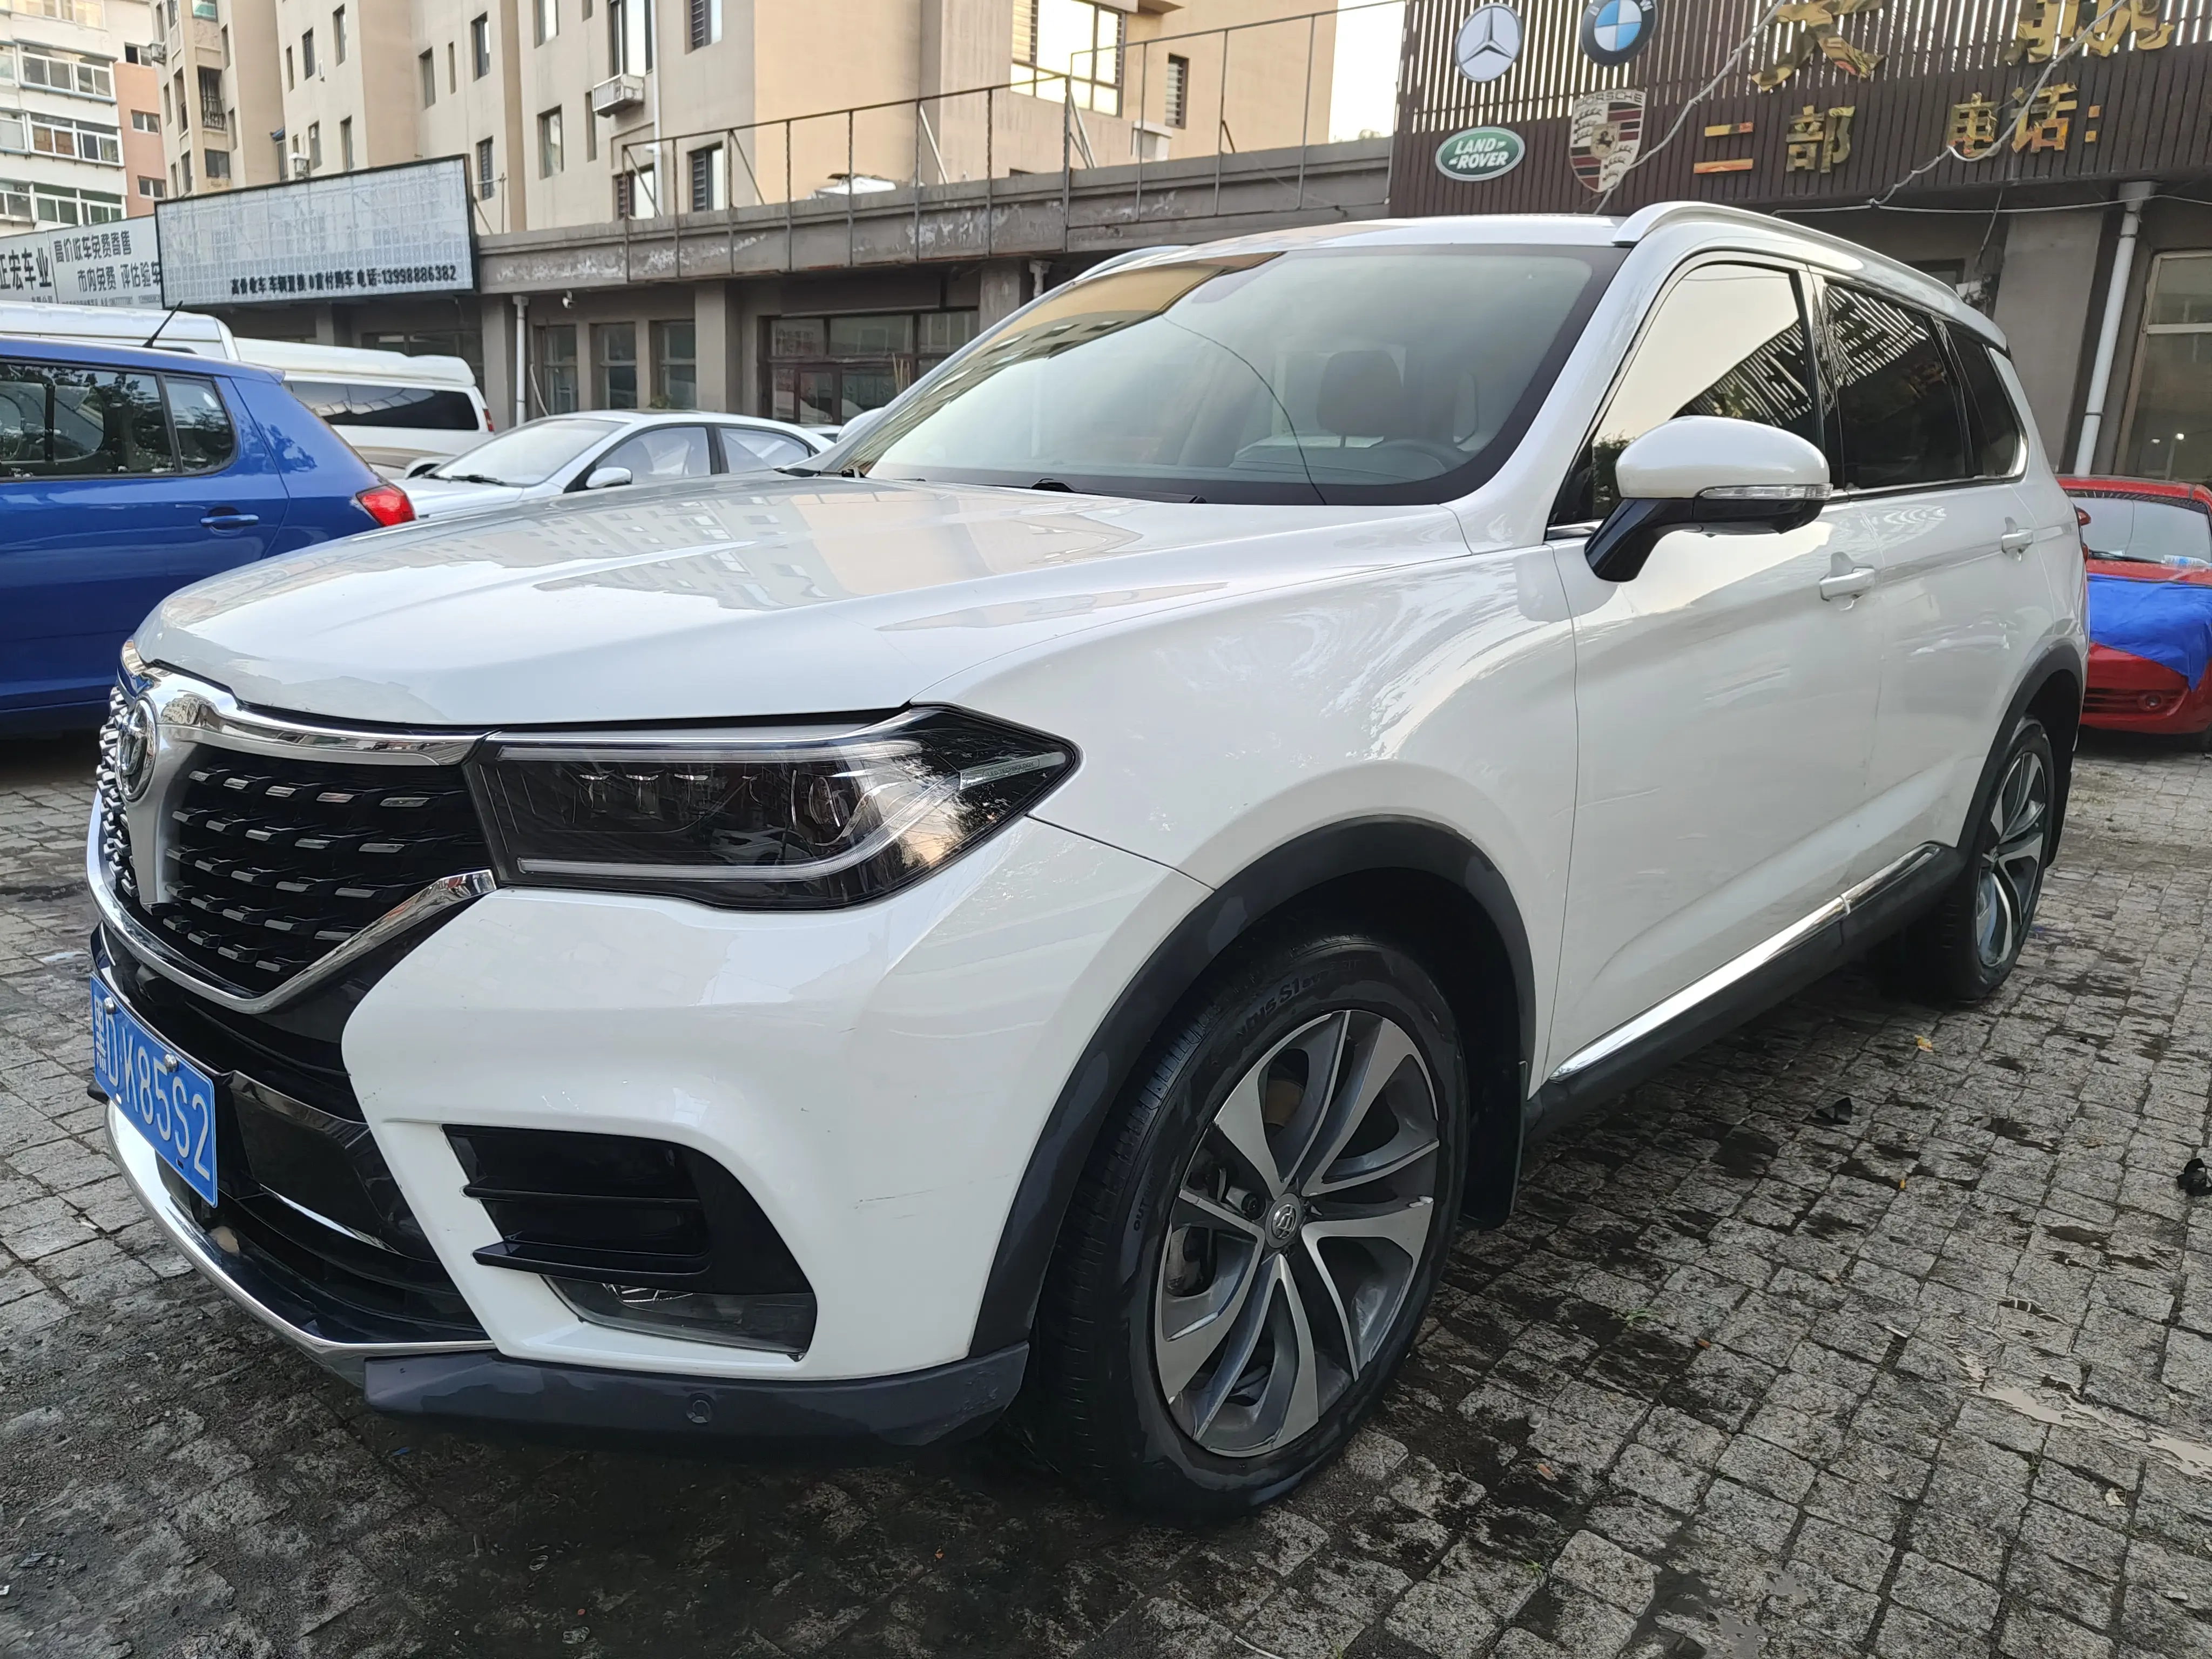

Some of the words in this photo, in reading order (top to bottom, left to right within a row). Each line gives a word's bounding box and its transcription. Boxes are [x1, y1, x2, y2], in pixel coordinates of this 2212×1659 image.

[1573, 91, 1643, 108] PORSCHE
[1454, 138, 1496, 155] LAND
[1694, 105, 1856, 173] 二部
[1456, 151, 1509, 169] ROVER
[54, 231, 131, 263] 高价收车免费寄售
